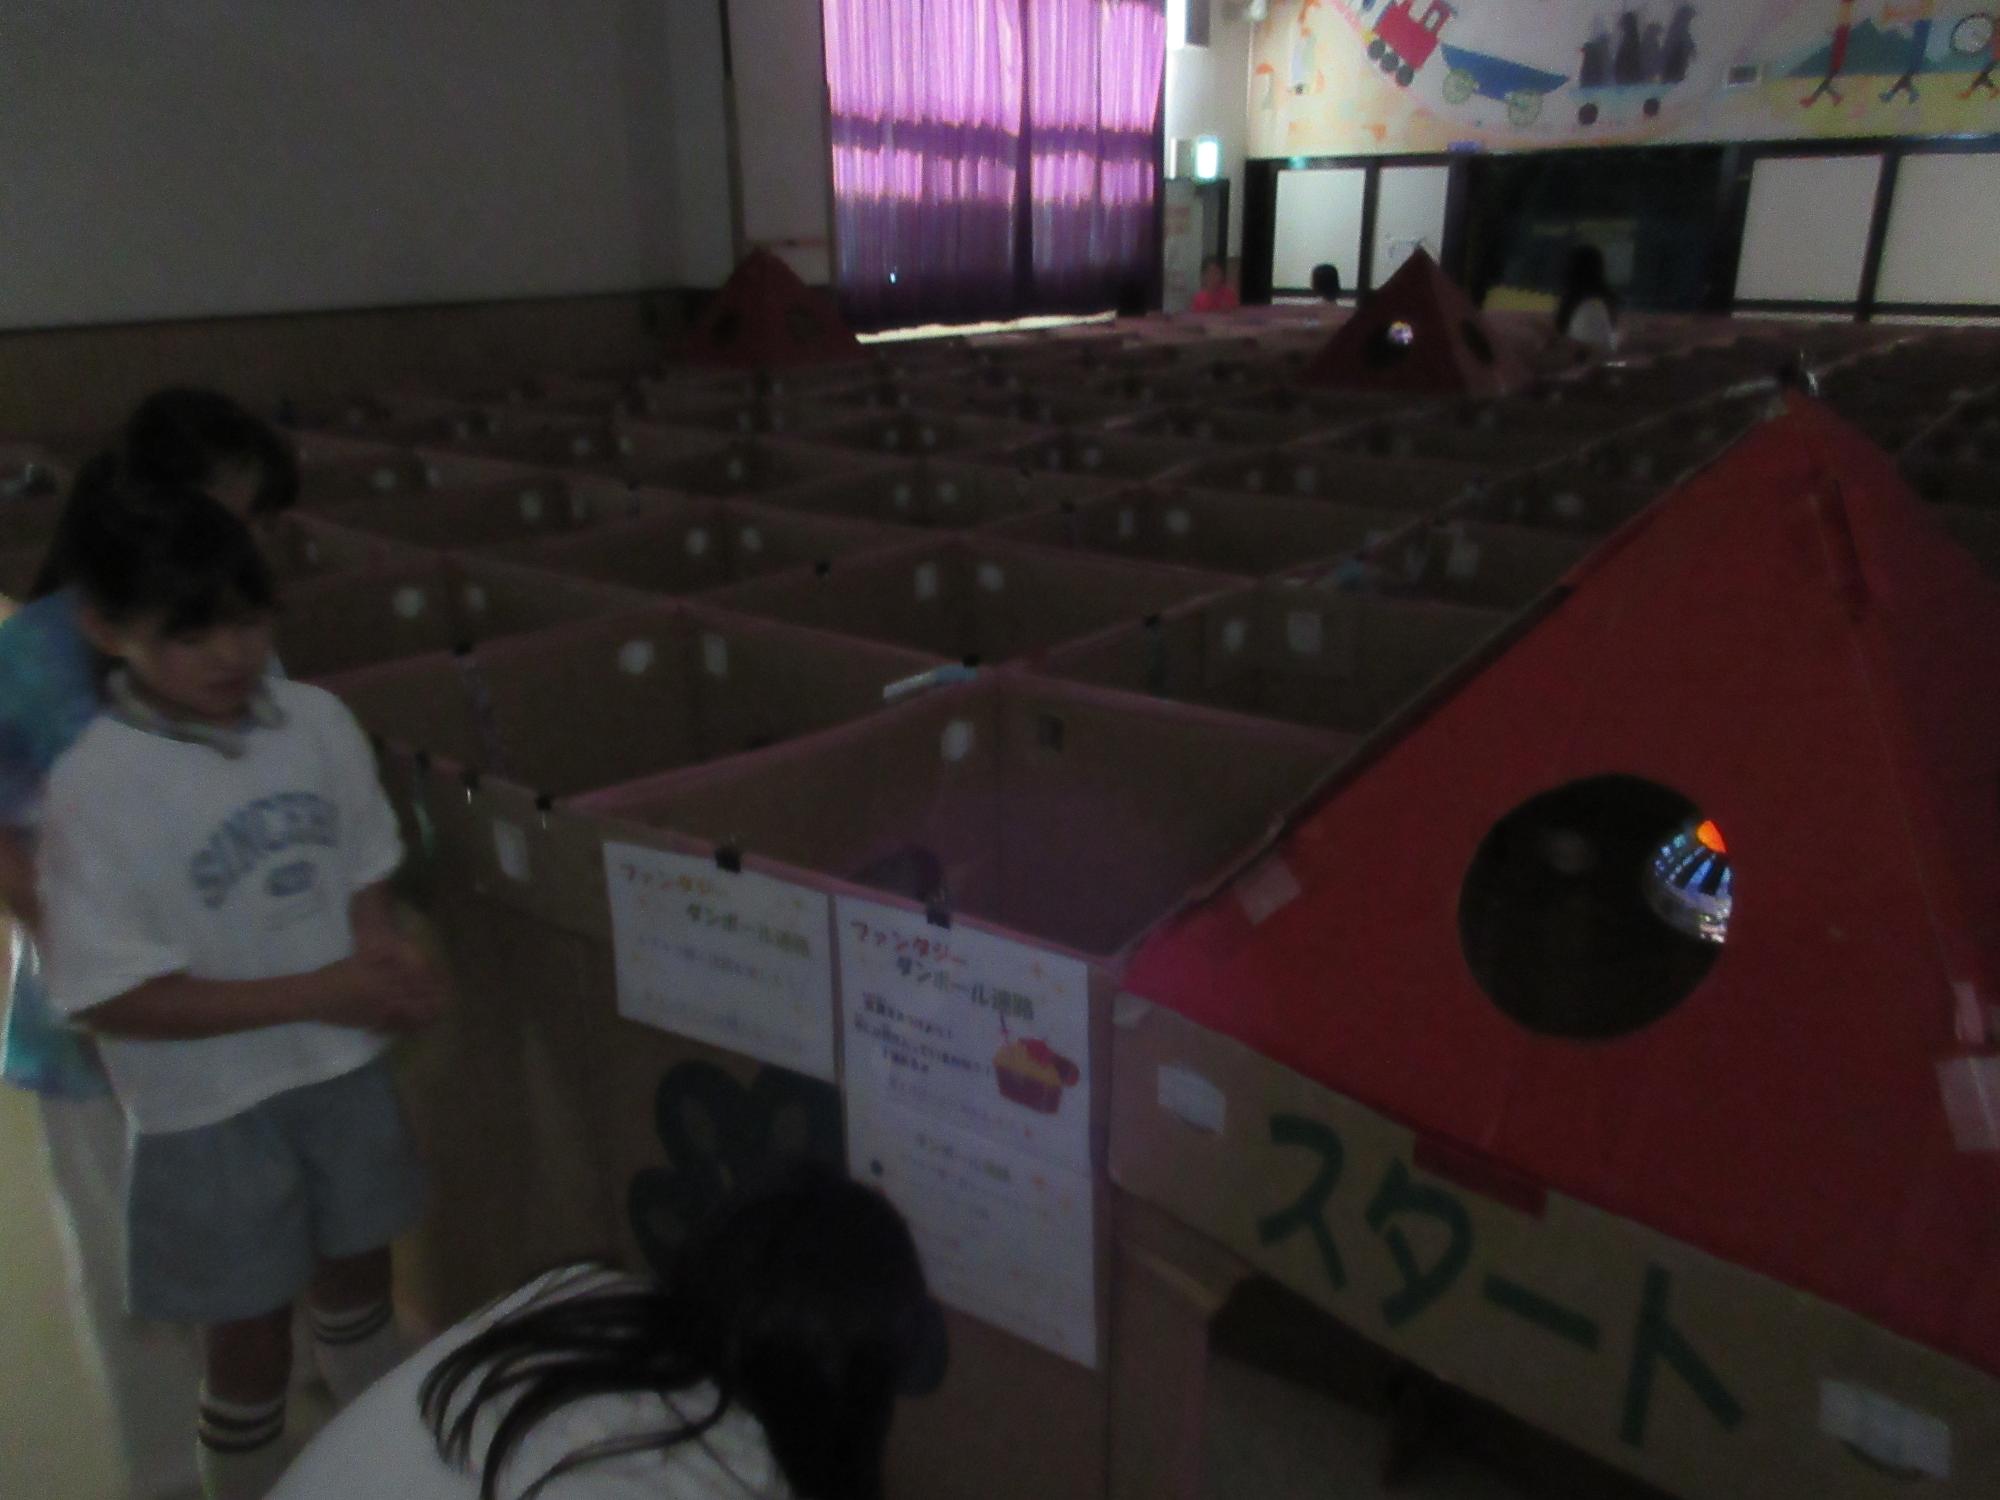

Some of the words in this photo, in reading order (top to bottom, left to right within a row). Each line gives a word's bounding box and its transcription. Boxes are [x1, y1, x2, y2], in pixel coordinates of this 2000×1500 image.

[850, 918, 968, 966] ファンタジー
[1261, 1115, 1744, 1448] スタート
